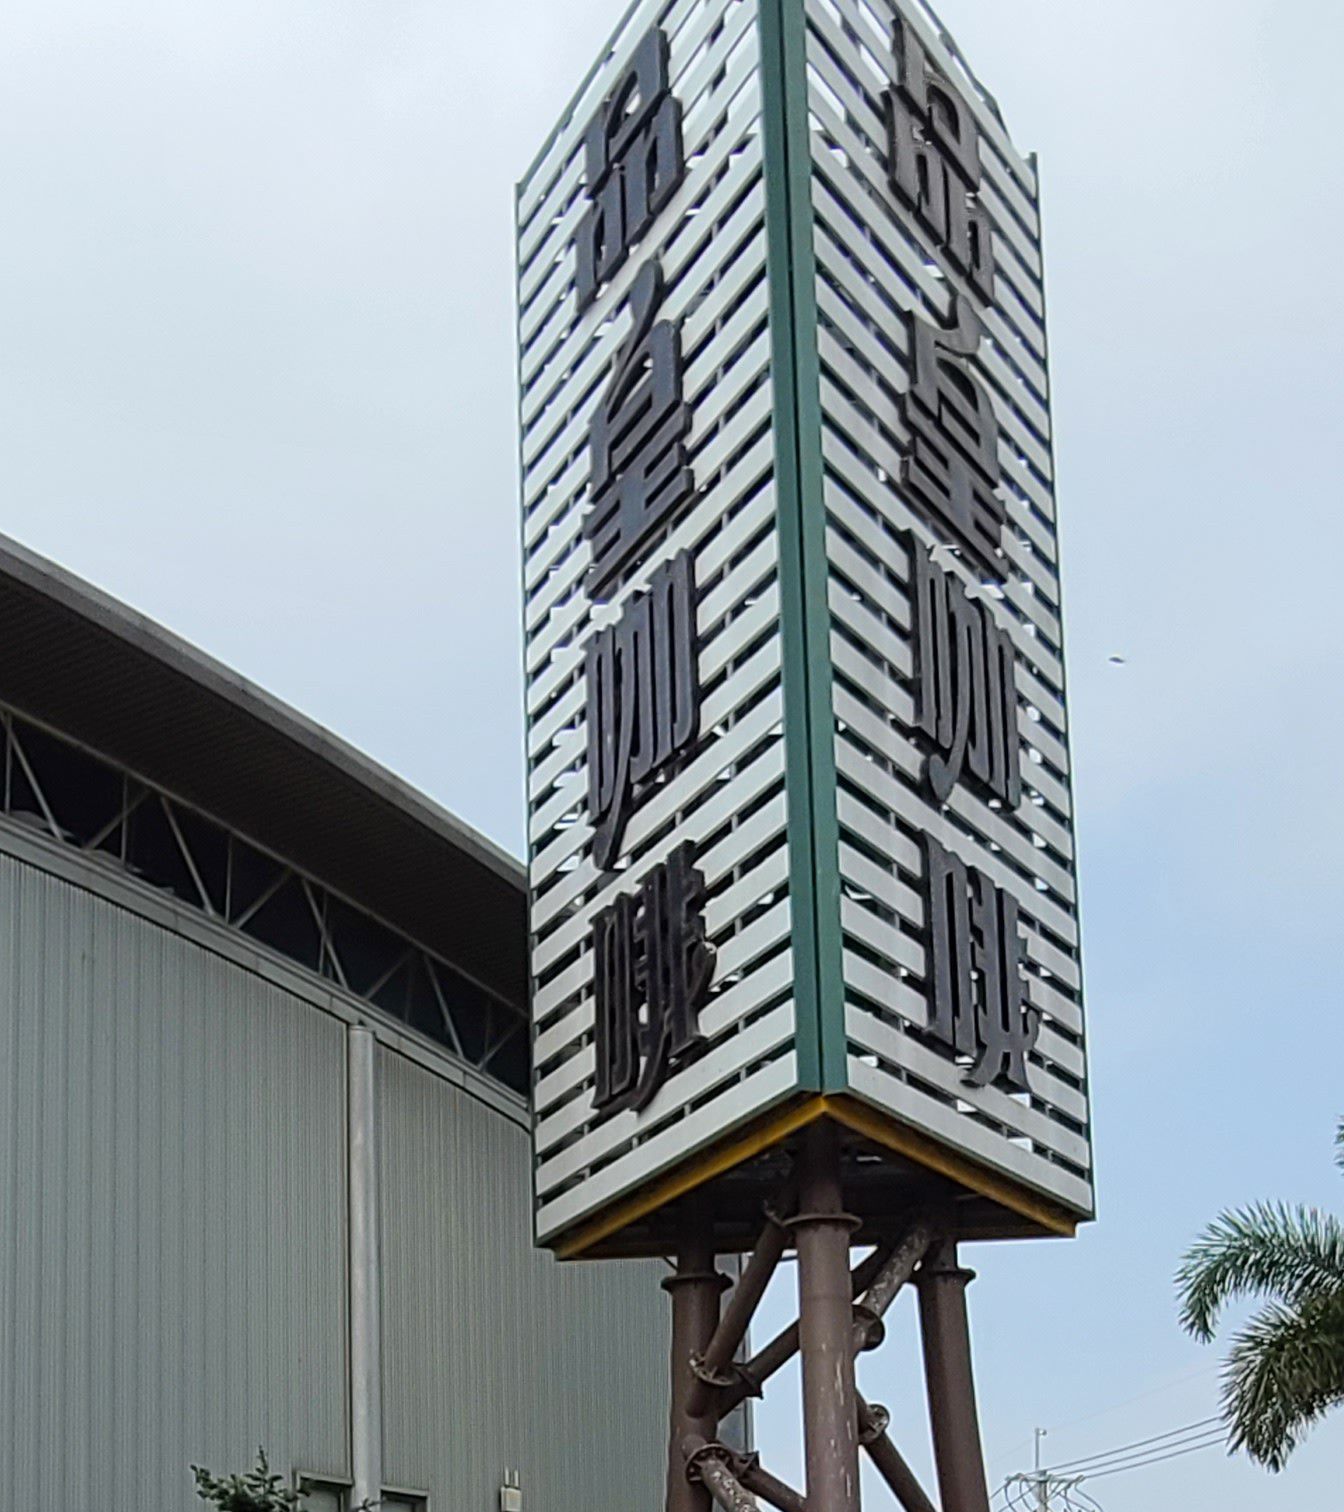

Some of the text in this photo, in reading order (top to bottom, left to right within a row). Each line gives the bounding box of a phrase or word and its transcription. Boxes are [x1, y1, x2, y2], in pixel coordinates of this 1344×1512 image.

[574, 25, 716, 1116] 品皇咖啡
[878, 18, 1042, 1095] 品皇咖啡
